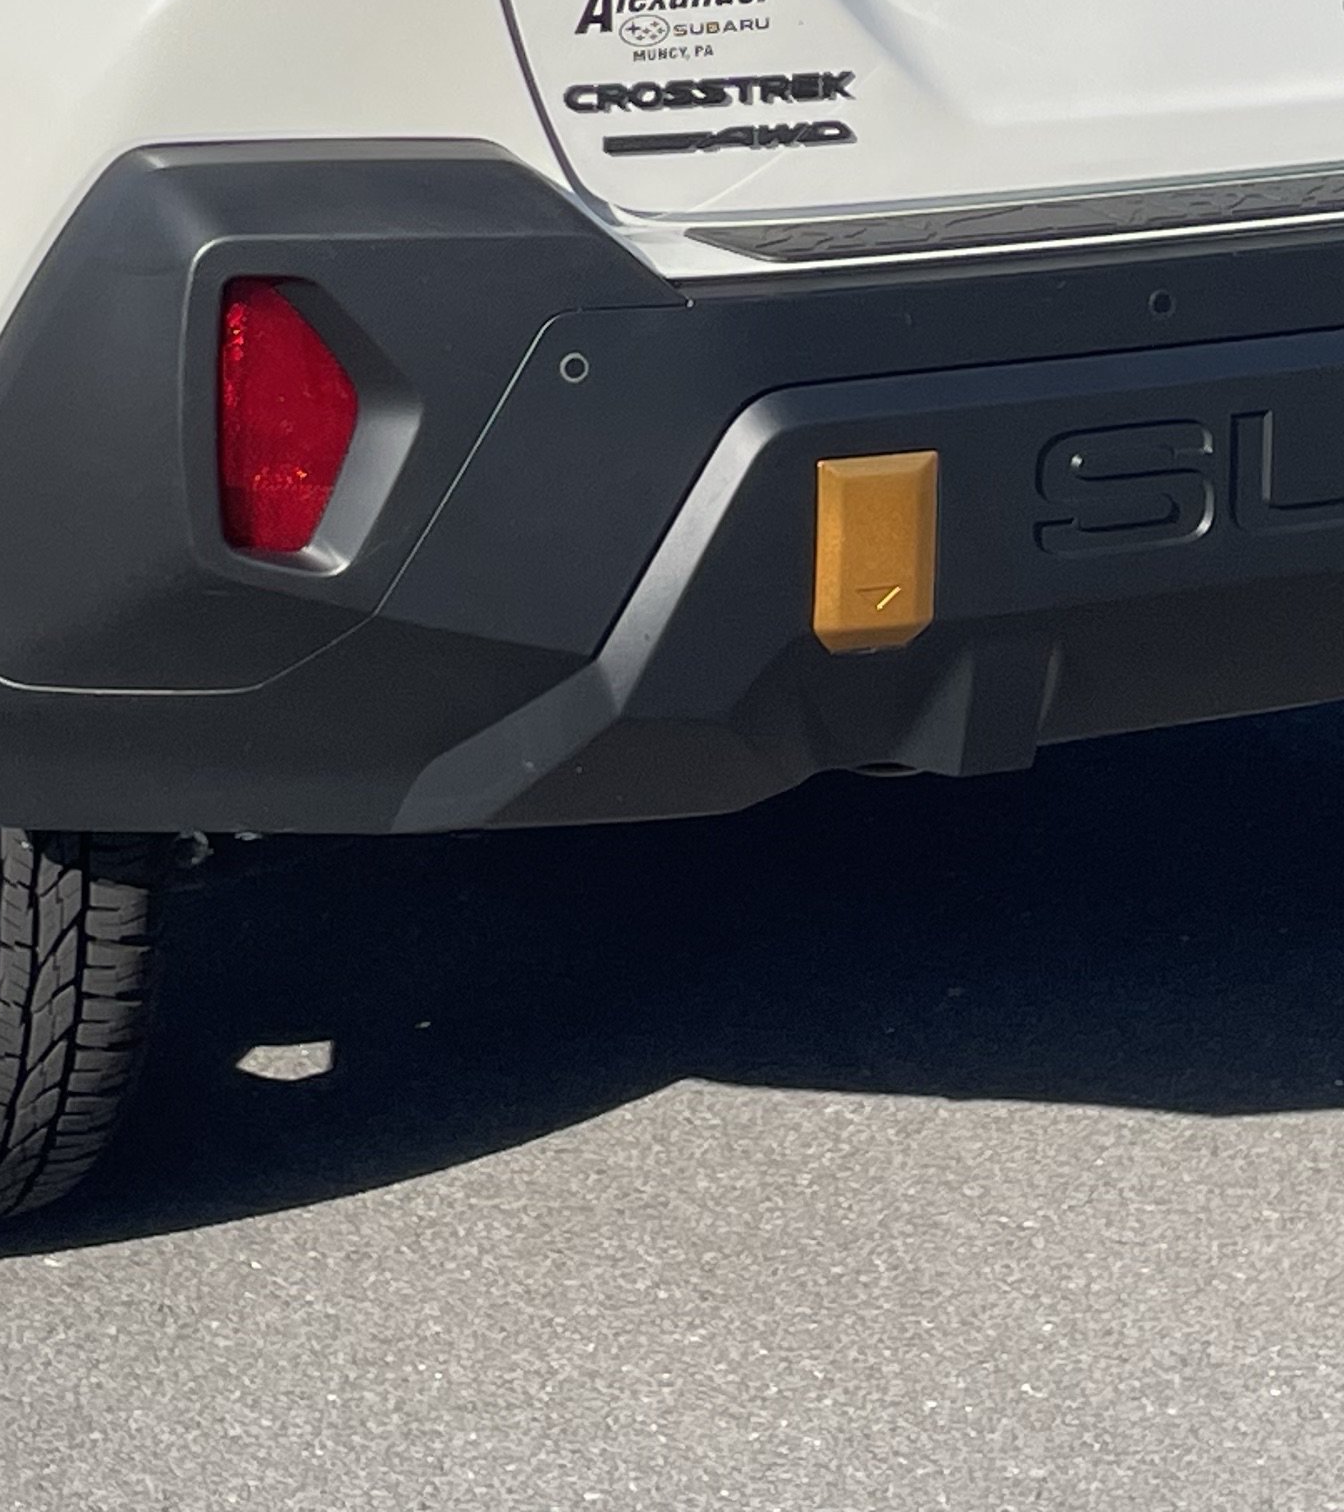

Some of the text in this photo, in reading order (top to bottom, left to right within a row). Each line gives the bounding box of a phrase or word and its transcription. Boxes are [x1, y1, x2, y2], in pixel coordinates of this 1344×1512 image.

[673, 17, 771, 37] SUBARU
[694, 45, 715, 59] PA
[563, 71, 856, 113] CROSSTREK
[712, 120, 858, 151] AWD
